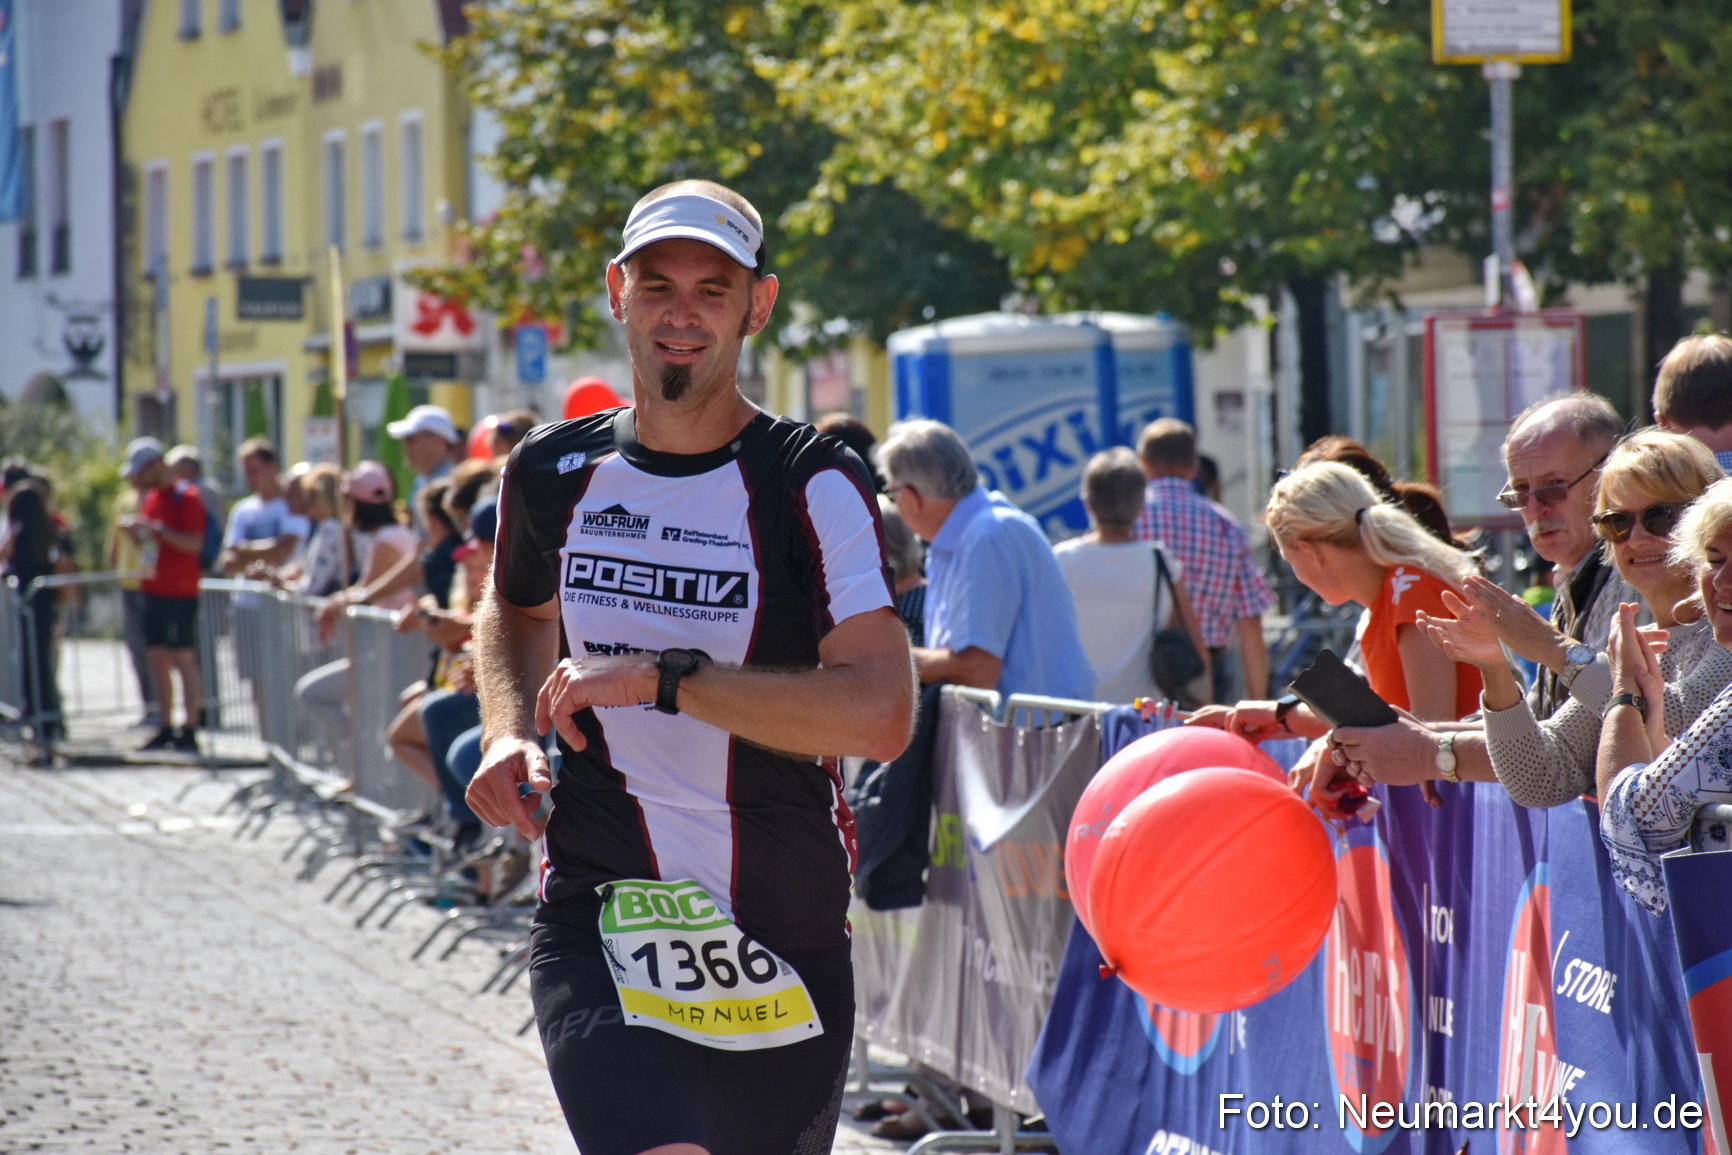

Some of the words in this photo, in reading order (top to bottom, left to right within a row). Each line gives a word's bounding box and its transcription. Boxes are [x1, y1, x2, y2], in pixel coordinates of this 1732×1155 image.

[580, 528, 647, 540] BAUUNTERNEHMEN
[582, 514, 650, 530] WOLFRUM
[683, 529, 728, 541] Raiffeisenbank
[568, 556, 742, 604] POSITIV
[564, 591, 576, 602] DIE
[577, 593, 618, 608] FITNESS
[620, 599, 630, 609] &
[633, 601, 739, 623] WELLNESSGRUPPE
[583, 640, 660, 657] BRÖT
[617, 889, 730, 923] BOC
[631, 932, 778, 991] 1366
[1557, 958, 1618, 1015] STORE
[668, 999, 789, 1026] MANUEL
